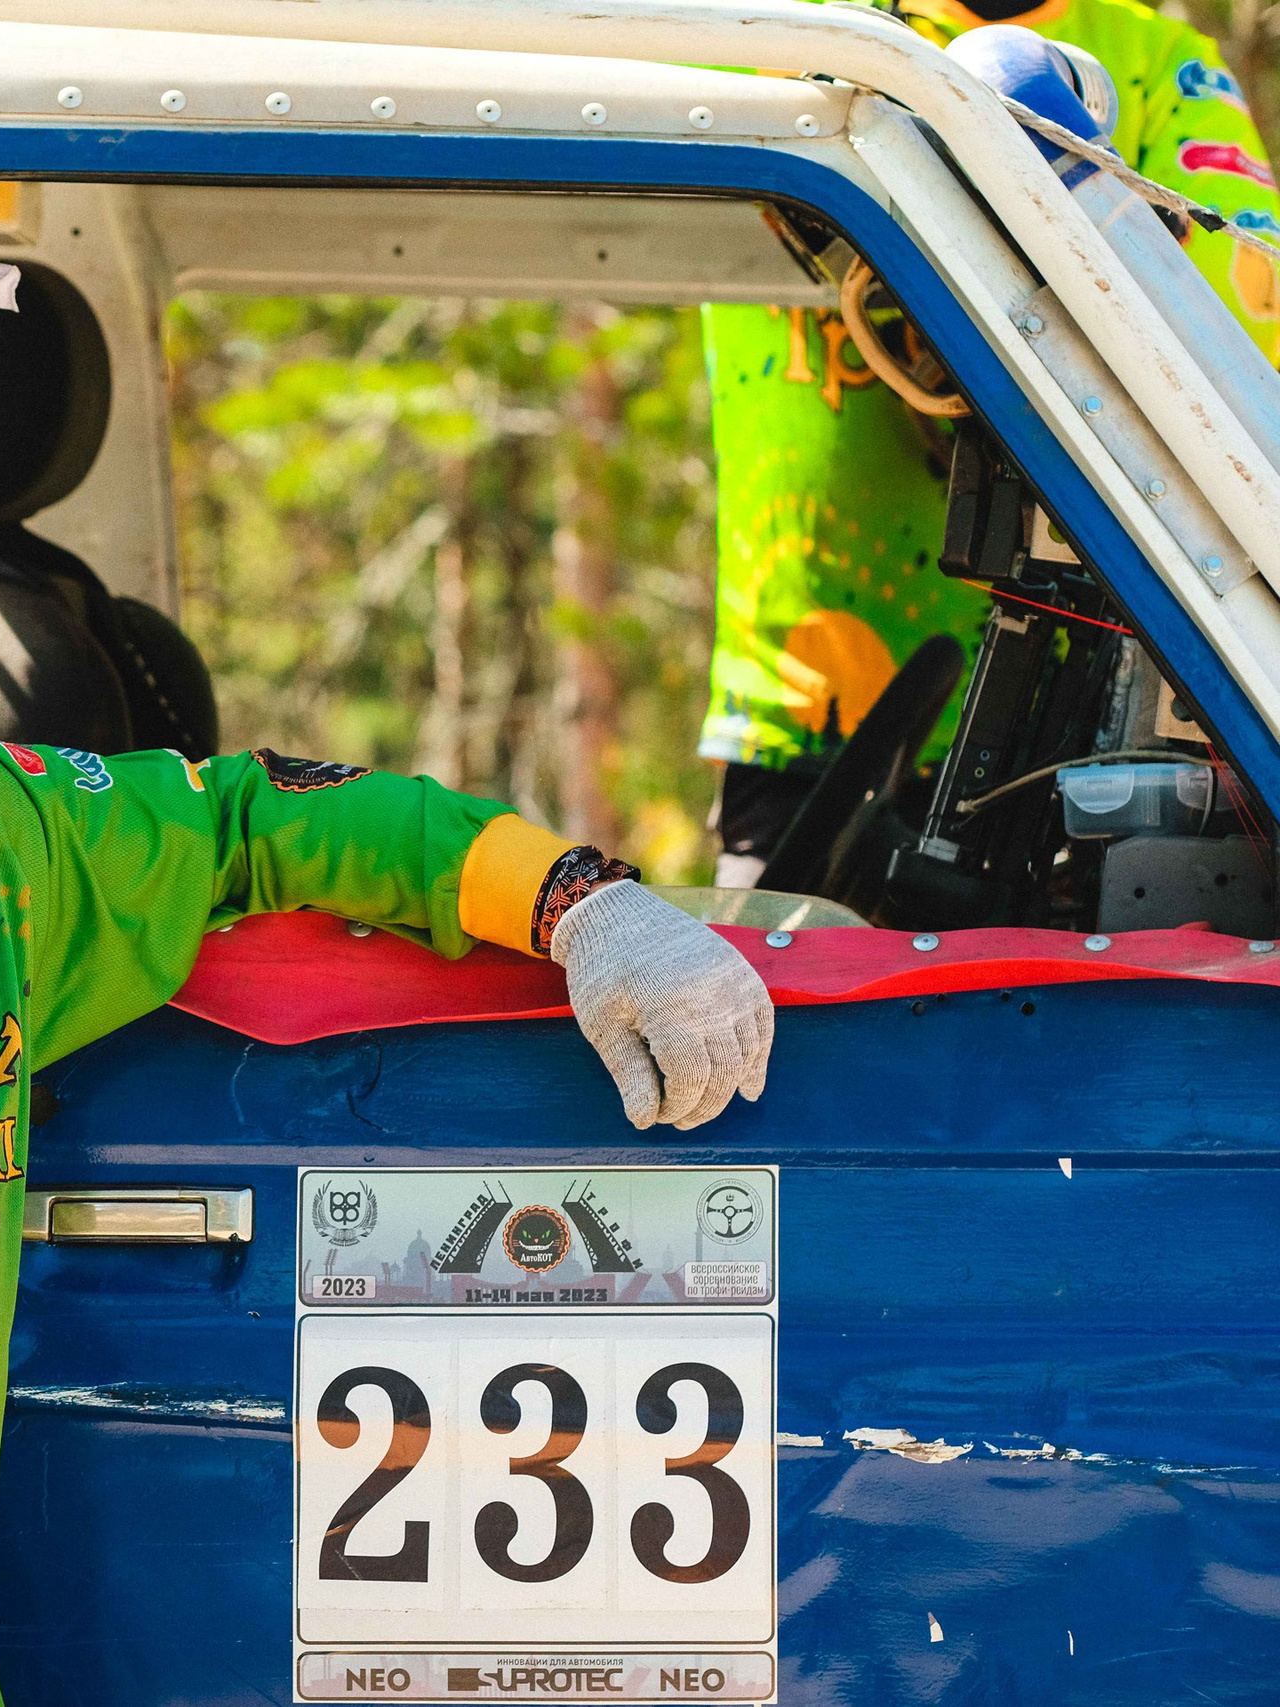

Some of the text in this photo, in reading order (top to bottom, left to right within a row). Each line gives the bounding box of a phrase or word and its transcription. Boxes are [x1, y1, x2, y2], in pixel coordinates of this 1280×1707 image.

[429, 1193, 489, 1271] ЛЕНИНГРАД
[586, 1191, 644, 1270] ТРОФИ
[691, 1262, 760, 1275] всероссийское
[321, 1278, 367, 1297] 2023
[693, 1275, 759, 1287] соревнование
[465, 1288, 608, 1303] 11-14 мая 2023
[687, 1286, 699, 1295] по
[317, 1362, 751, 1584] 233
[497, 1658, 624, 1667] ИННОВАЦИИ ДЛЯ АВТОМОБИЛЯ
[345, 1667, 726, 1693] NEO SUPROTEC NEO
